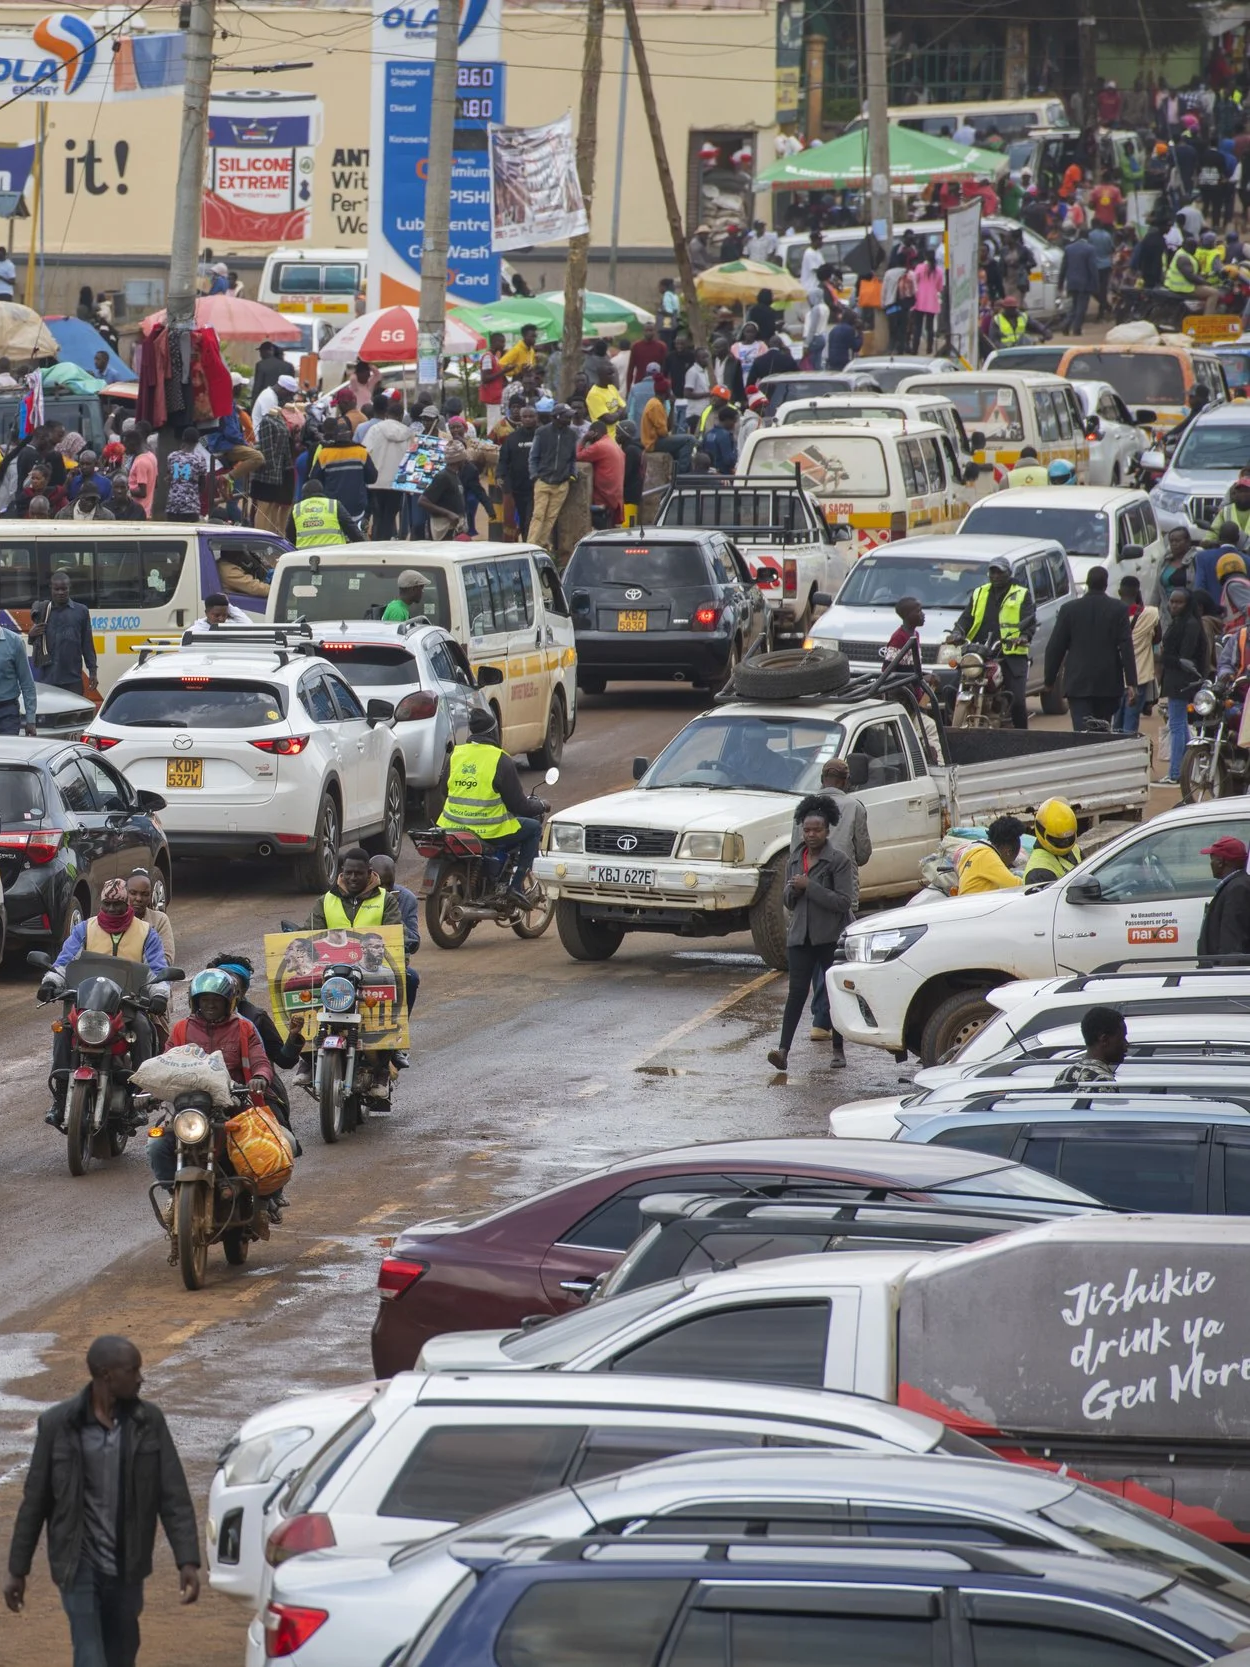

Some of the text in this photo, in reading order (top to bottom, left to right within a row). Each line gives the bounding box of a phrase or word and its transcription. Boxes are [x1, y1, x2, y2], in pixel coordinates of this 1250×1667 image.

[382, 8, 439, 28] OLA
[390, 68, 430, 77] Unleaded
[390, 78, 417, 88] Super
[12, 86, 59, 96] ENERGY
[390, 104, 417, 113] Diesel
[388, 135, 428, 144] Kerosene
[65, 139, 129, 196] it!
[218, 158, 293, 172] SILICONE
[218, 176, 290, 190] EXTREME
[396, 217, 490, 232] Lub entre
[455, 273, 489, 286] Card
[380, 329, 406, 343] 5G
[828, 503, 854, 515] SACCO
[625, 610, 646, 621] KBZ
[110, 616, 141, 630] SACCO
[175, 760, 200, 773] KDP
[168, 774, 199, 786] 537W
[598, 867, 652, 885] KBJ 627E
[1138, 911, 1173, 919] Unauthorised
[1125, 919, 1155, 927] Passengers
[361, 986, 388, 999] tter.
[1060, 1266, 1216, 1327] Jishikie
[1070, 1316, 1225, 1376] drink ya
[1082, 1352, 1250, 1421] Gen More
